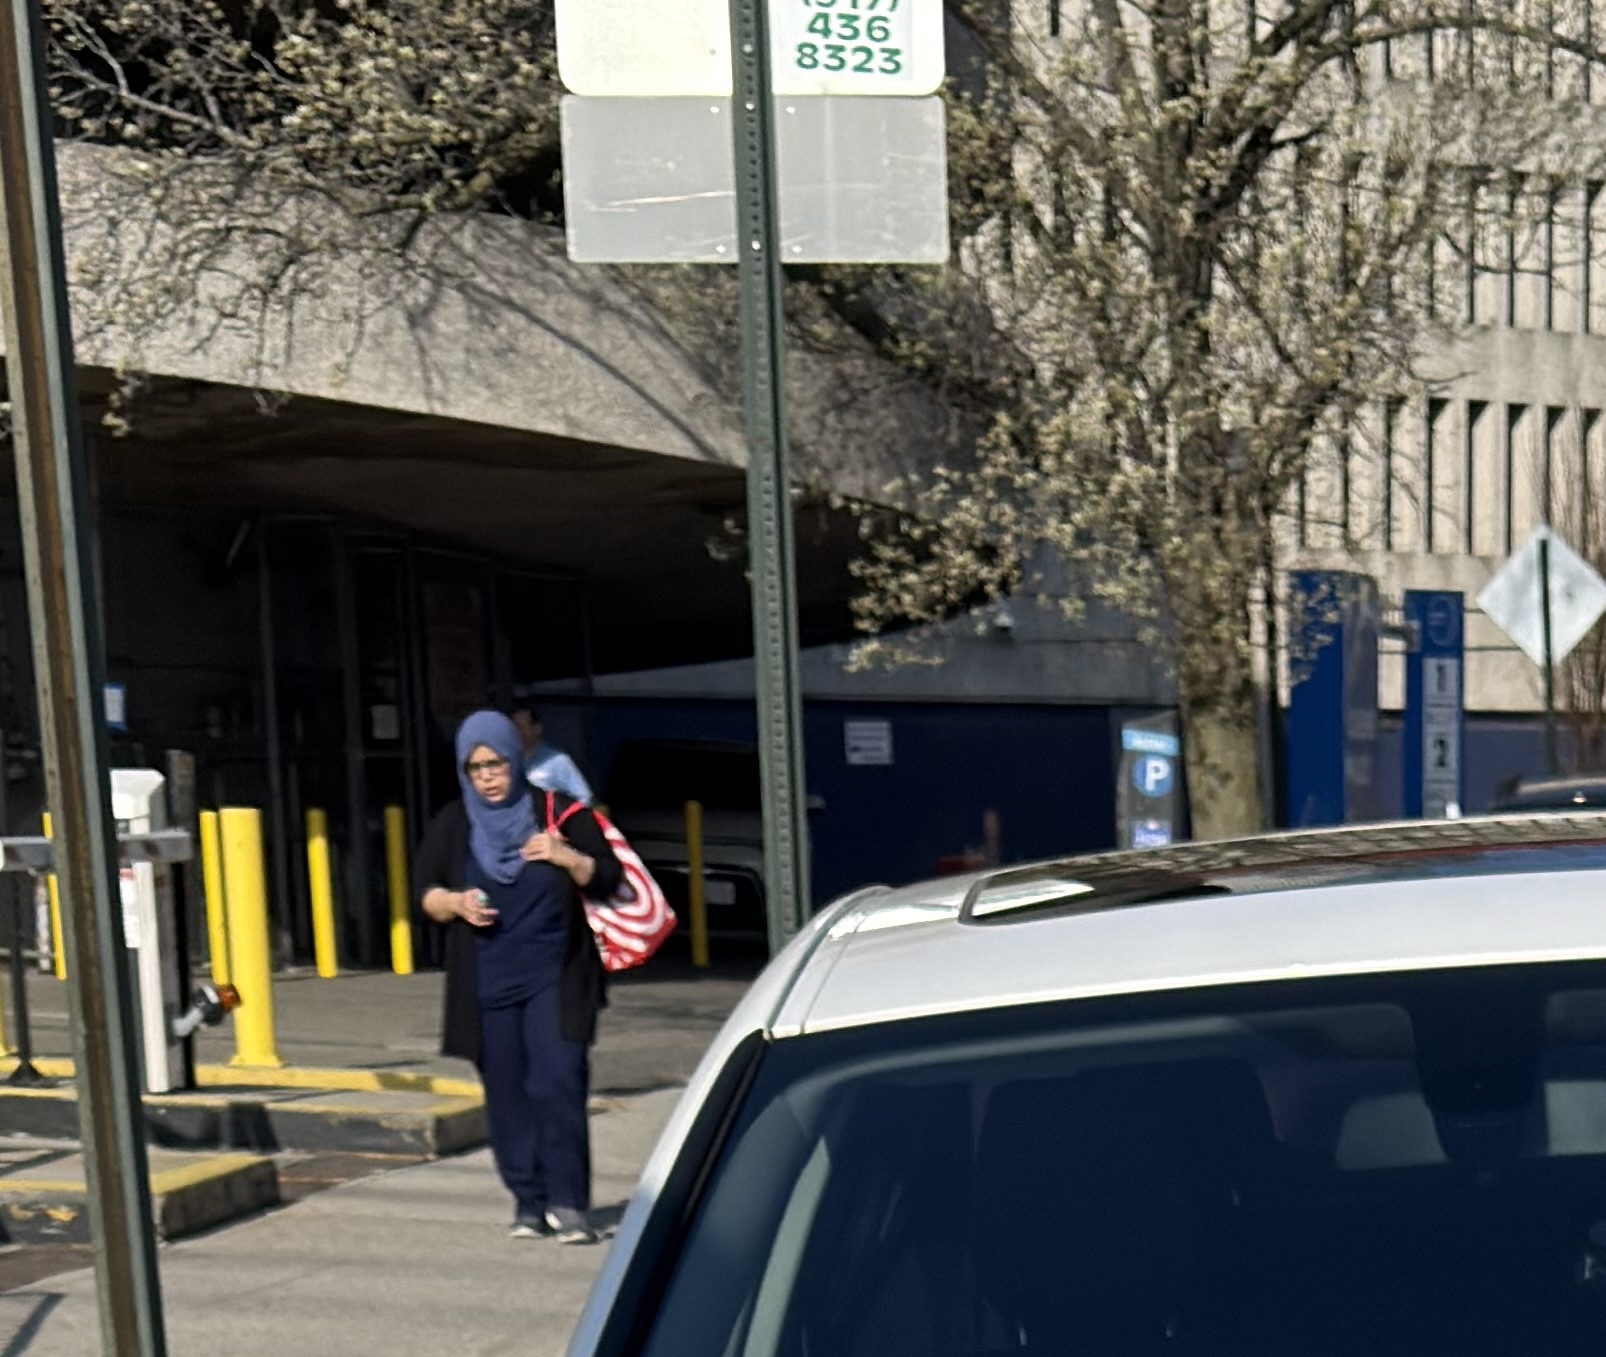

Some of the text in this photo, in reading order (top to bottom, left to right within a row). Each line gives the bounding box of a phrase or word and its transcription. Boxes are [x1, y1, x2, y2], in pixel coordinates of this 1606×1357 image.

[807, 12, 890, 42] 436
[796, 42, 902, 74] 8323
[1145, 758, 1169, 791] P
